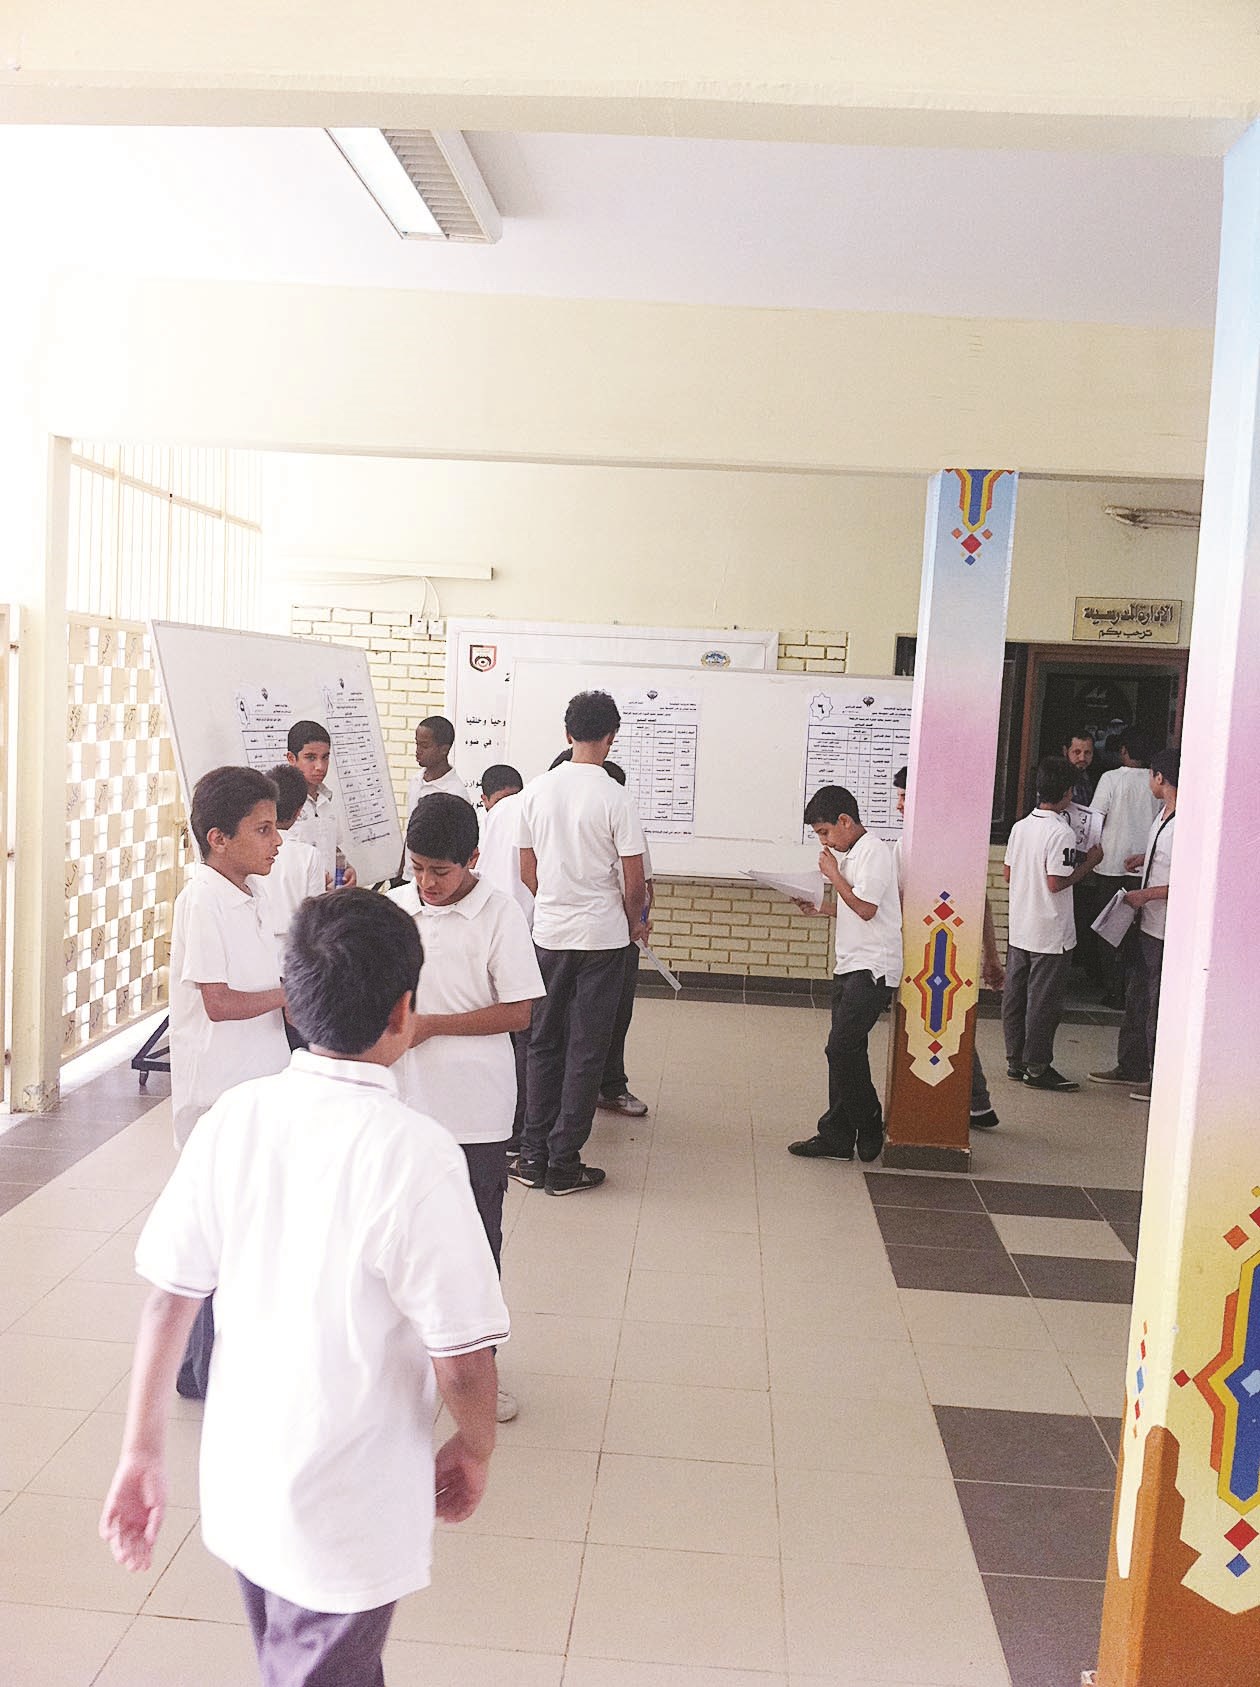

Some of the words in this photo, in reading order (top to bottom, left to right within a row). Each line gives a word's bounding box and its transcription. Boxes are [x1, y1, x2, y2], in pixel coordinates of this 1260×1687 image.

[1084, 603, 1137, 625] المدرسية
[1098, 626, 1122, 640] بكم
[1123, 628, 1153, 640] ترحب
[817, 703, 825, 714] ٦
